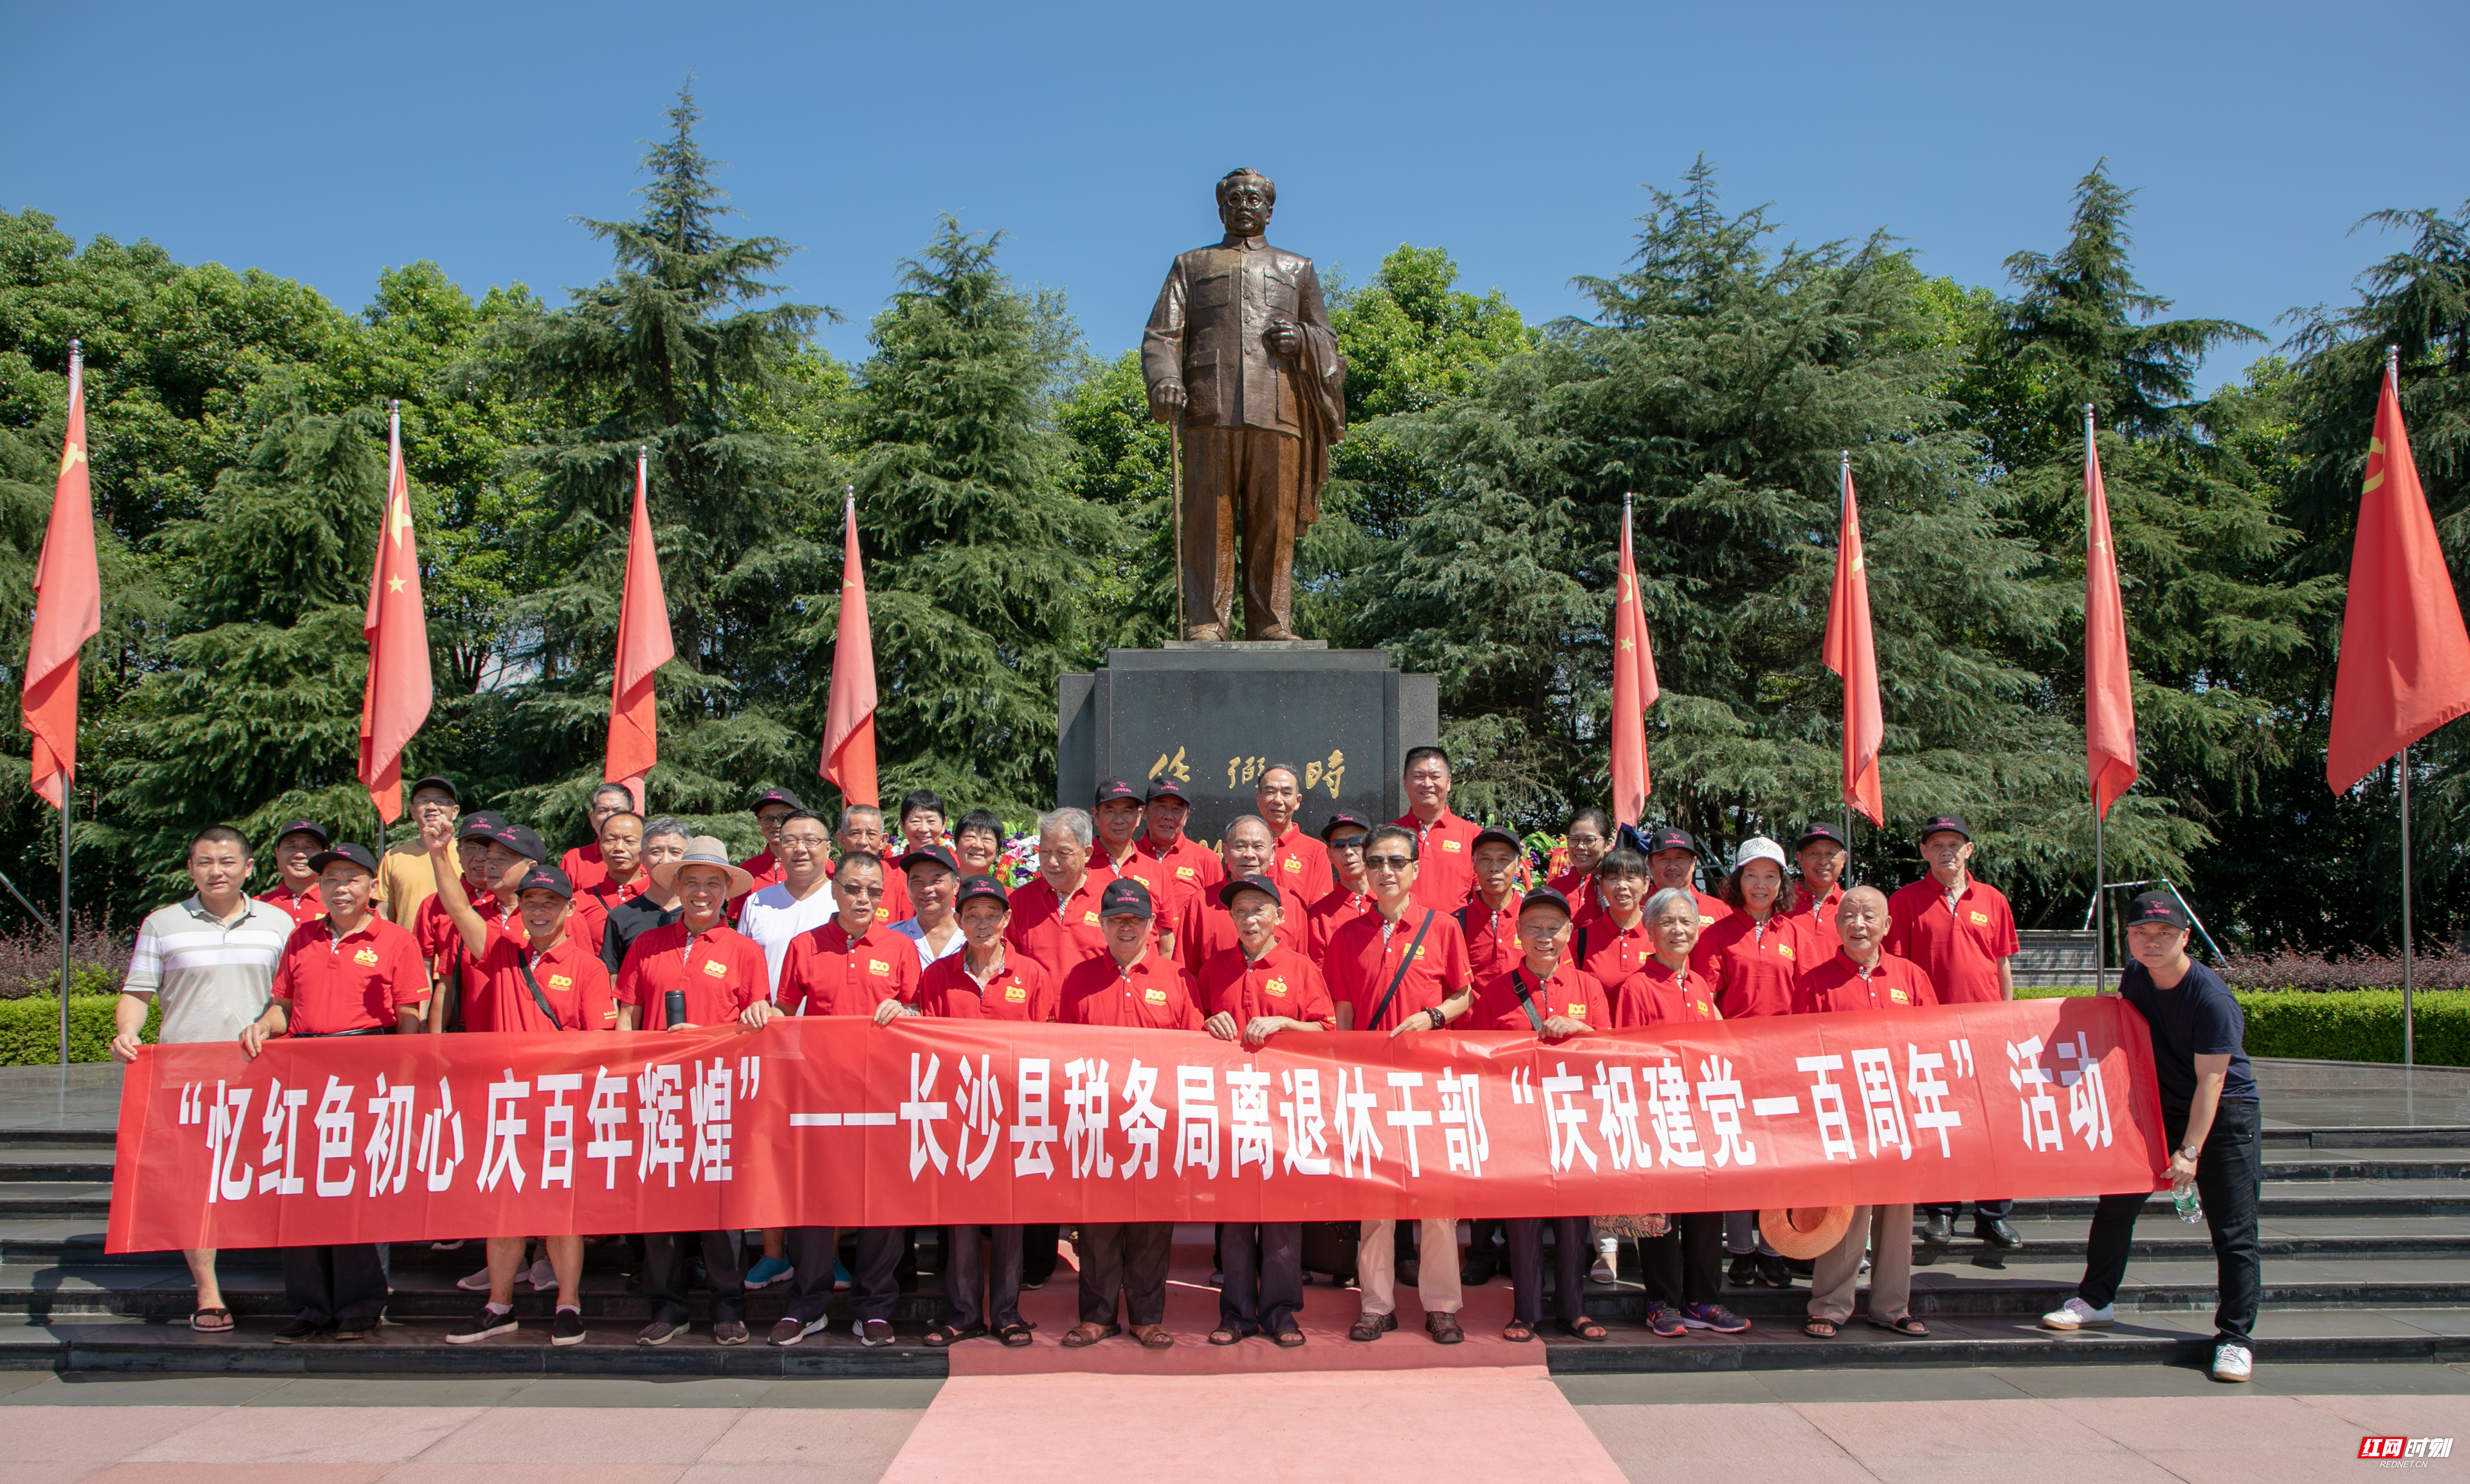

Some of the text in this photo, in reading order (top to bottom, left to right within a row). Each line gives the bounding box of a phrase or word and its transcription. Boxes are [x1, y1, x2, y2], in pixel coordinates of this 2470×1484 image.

[1442, 839, 1461, 849] 100
[1284, 859, 1301, 870] 100
[1176, 866, 1194, 877] 100
[1970, 911, 1988, 923] 100
[354, 949, 378, 962] 100
[704, 960, 727, 974] 100
[869, 959, 890, 972] 100
[548, 975, 571, 987] 100
[1265, 979, 1287, 993] 100
[1005, 986, 1026, 998] 100
[1145, 989, 1166, 1000] 100
[1568, 1003, 1586, 1014] 100
